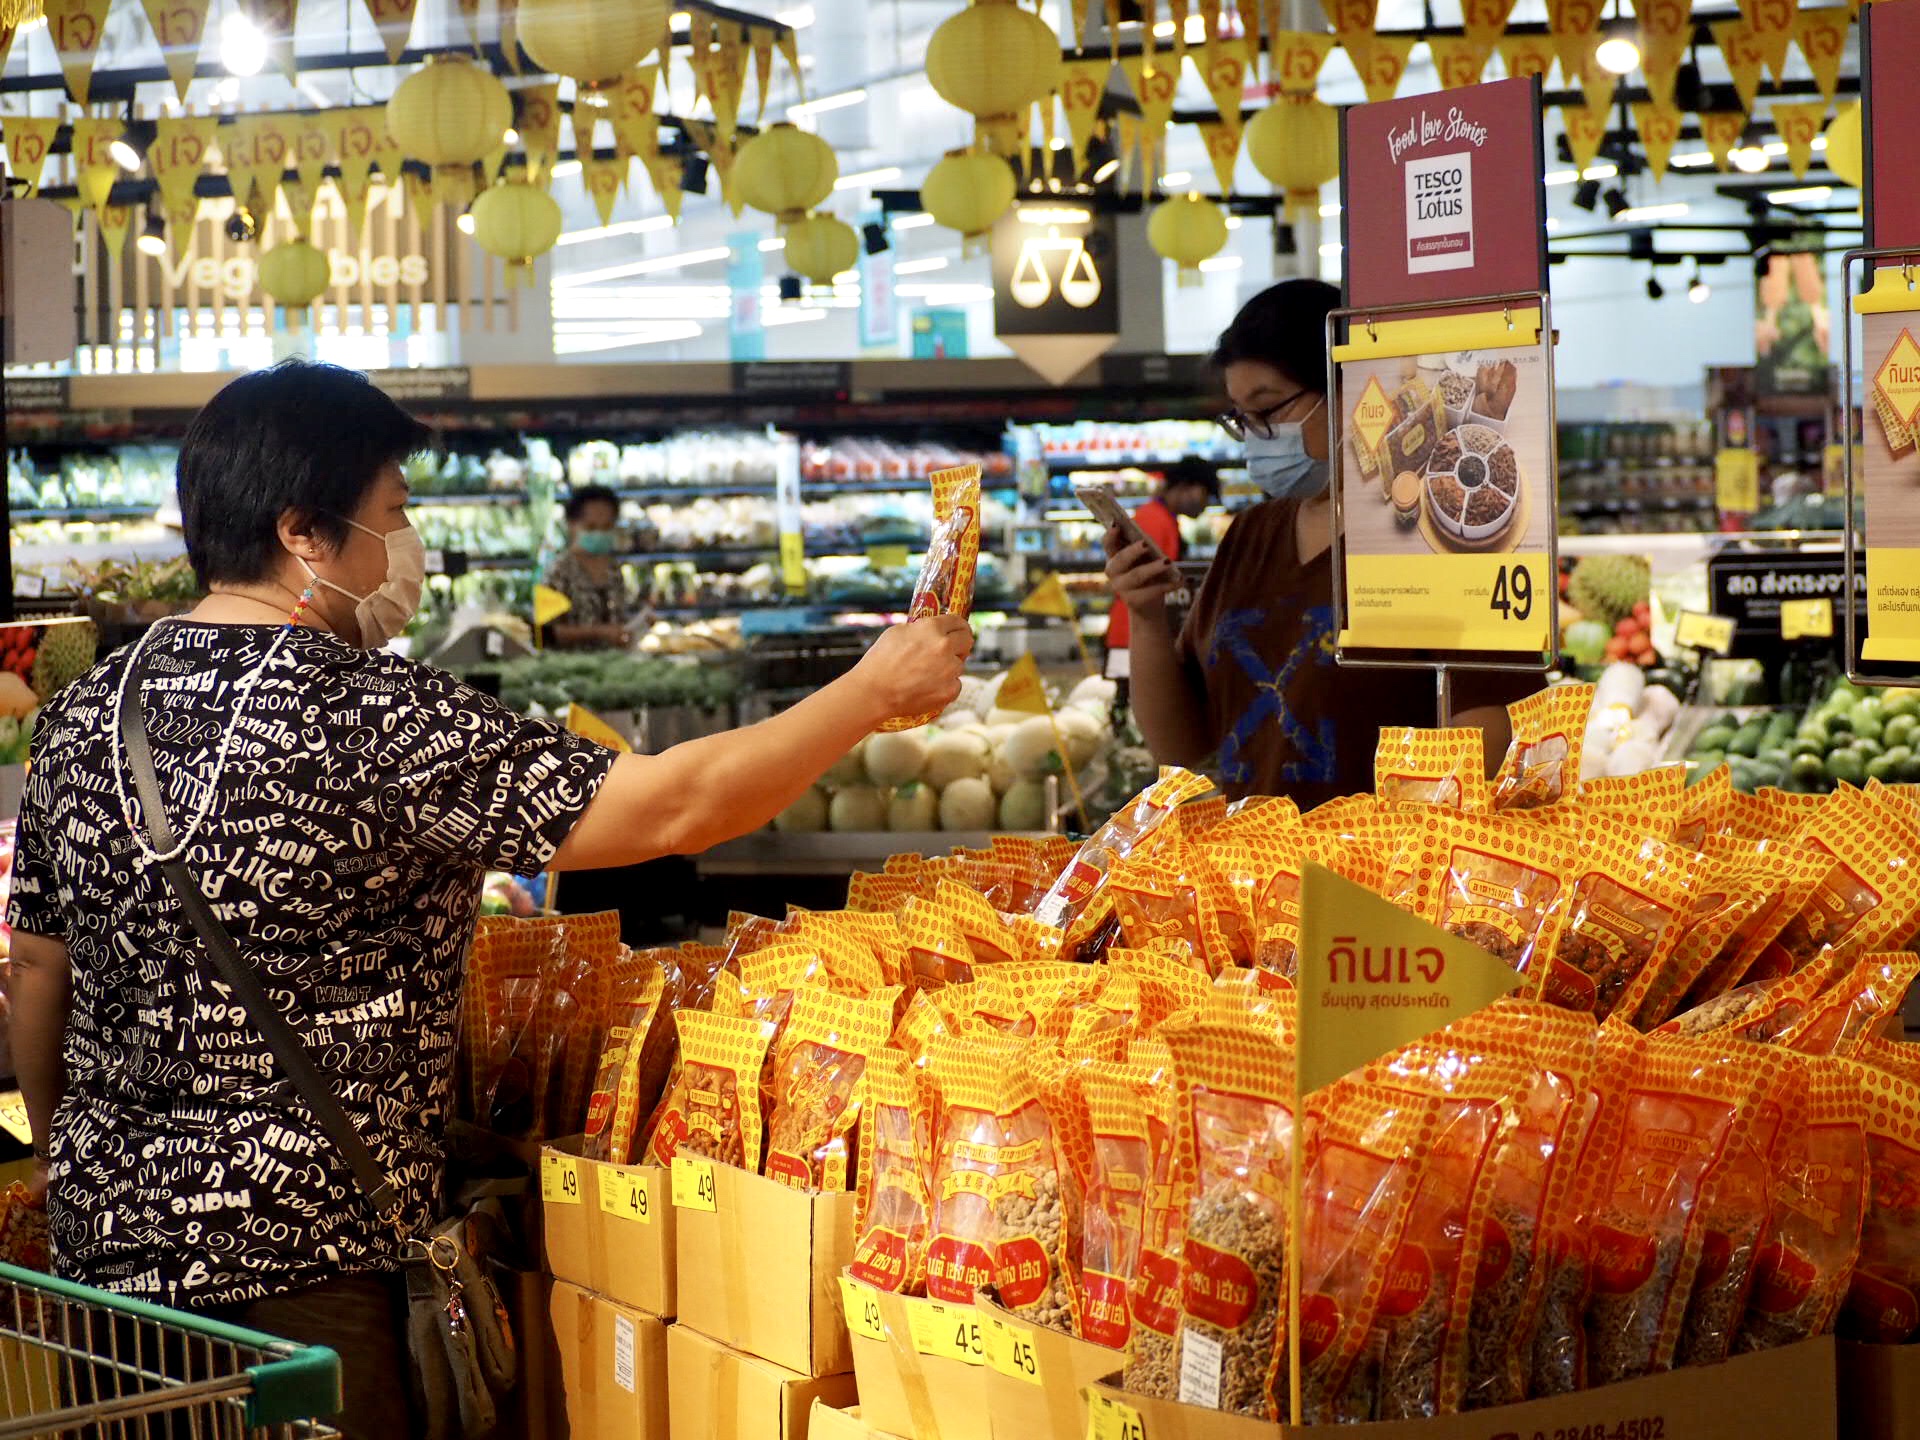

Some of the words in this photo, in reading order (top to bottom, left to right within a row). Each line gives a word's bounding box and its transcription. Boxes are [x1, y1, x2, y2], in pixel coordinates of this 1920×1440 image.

[1388, 117, 1417, 165] Food
[1421, 111, 1444, 147] Love
[1444, 107, 1488, 147] Stories
[1414, 168, 1462, 190] TESCO
[1418, 197, 1463, 220] Lotus
[162, 252, 428, 299] Vegbles
[1361, 402, 1384, 419] กินเจ
[1490, 565, 1532, 620] 49
[173, 628, 218, 652] STOP
[148, 654, 196, 674] WHAT
[163, 692, 196, 710] you
[514, 750, 562, 797] HOPE
[260, 780, 348, 816] SMILE
[67, 816, 102, 847] HOPE
[222, 812, 286, 837] hope
[291, 815, 348, 853] PART
[255, 834, 317, 866] HOPE
[112, 870, 129, 885] 10
[335, 887, 355, 900] 10
[249, 919, 313, 946] LOOK
[340, 947, 387, 981] STOP
[1328, 937, 1445, 984] กินเจ
[296, 962, 337, 991] SEE
[315, 986, 371, 1003] WHAT
[353, 1023, 392, 1042] you
[262, 1123, 317, 1157] HOPE
[121, 1153, 135, 1167] 10
[161, 1156, 201, 1186] hello
[59, 1178, 97, 1211] LOOK
[328, 1185, 346, 1200] 10
[563, 1170, 577, 1196] 49
[698, 1174, 713, 1202] 49
[171, 1189, 251, 1214] make
[630, 1187, 647, 1216] 49
[237, 1211, 302, 1247] LOOK
[865, 1301, 880, 1332] 49
[955, 1323, 982, 1355] 45
[1013, 1341, 1035, 1375] 45
